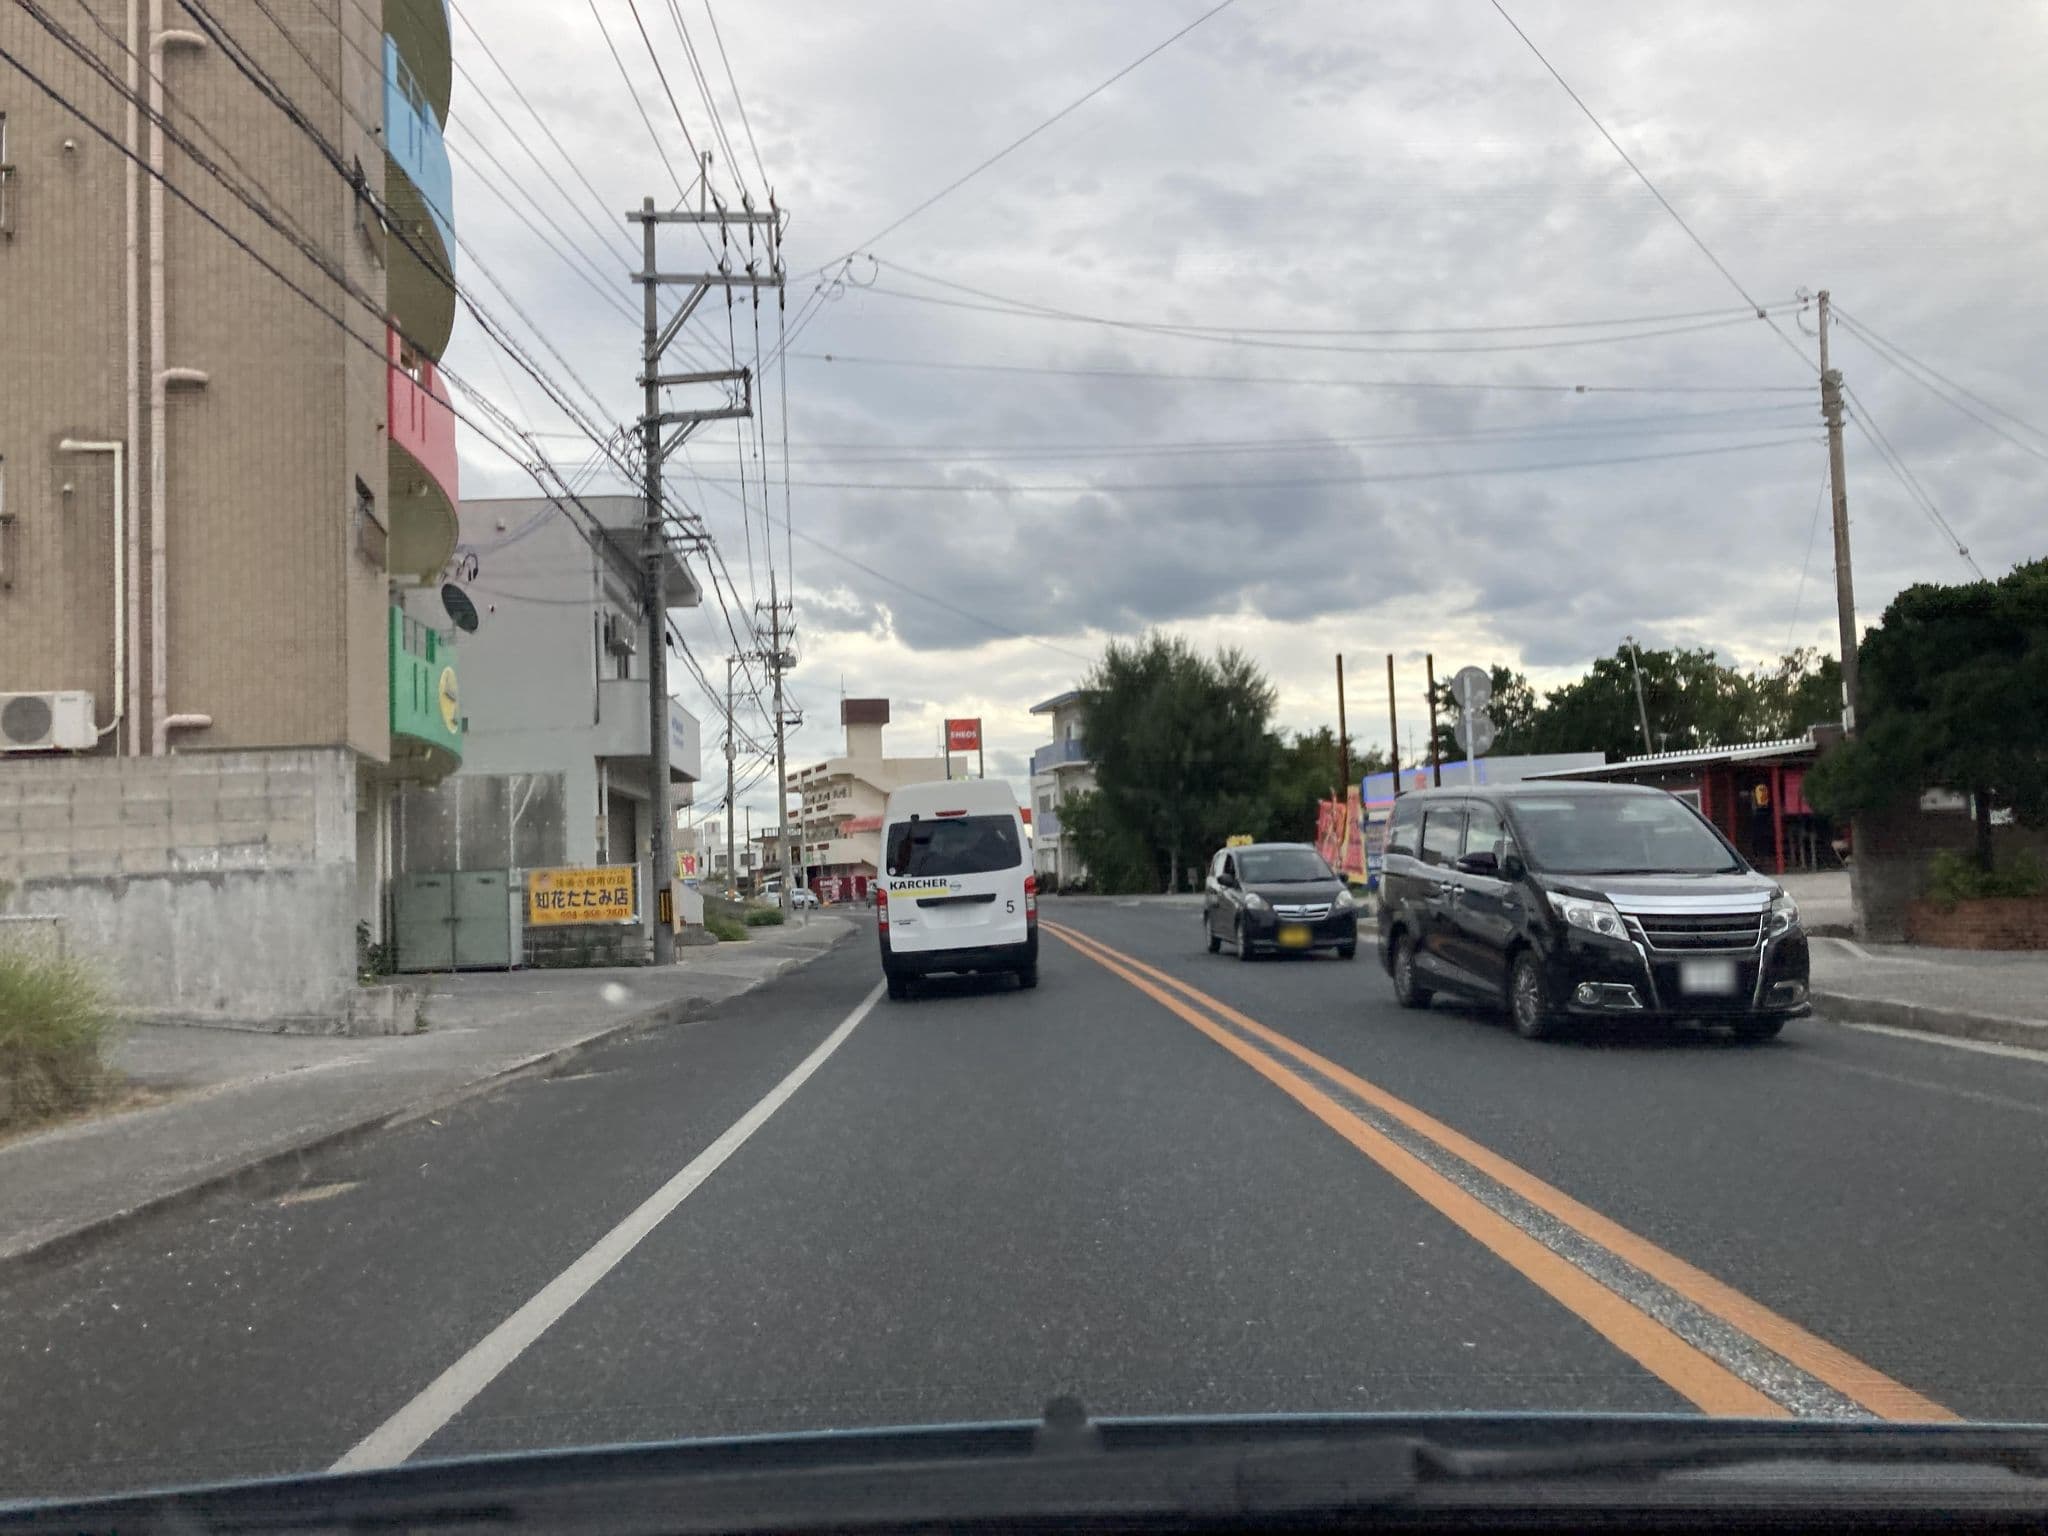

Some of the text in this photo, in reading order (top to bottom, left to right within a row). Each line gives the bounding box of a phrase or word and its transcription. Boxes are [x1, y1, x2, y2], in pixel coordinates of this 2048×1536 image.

[951, 730, 977, 739] ENEOS
[535, 888, 629, 909] 知花たたみ店
[1006, 899, 1015, 914] 5
